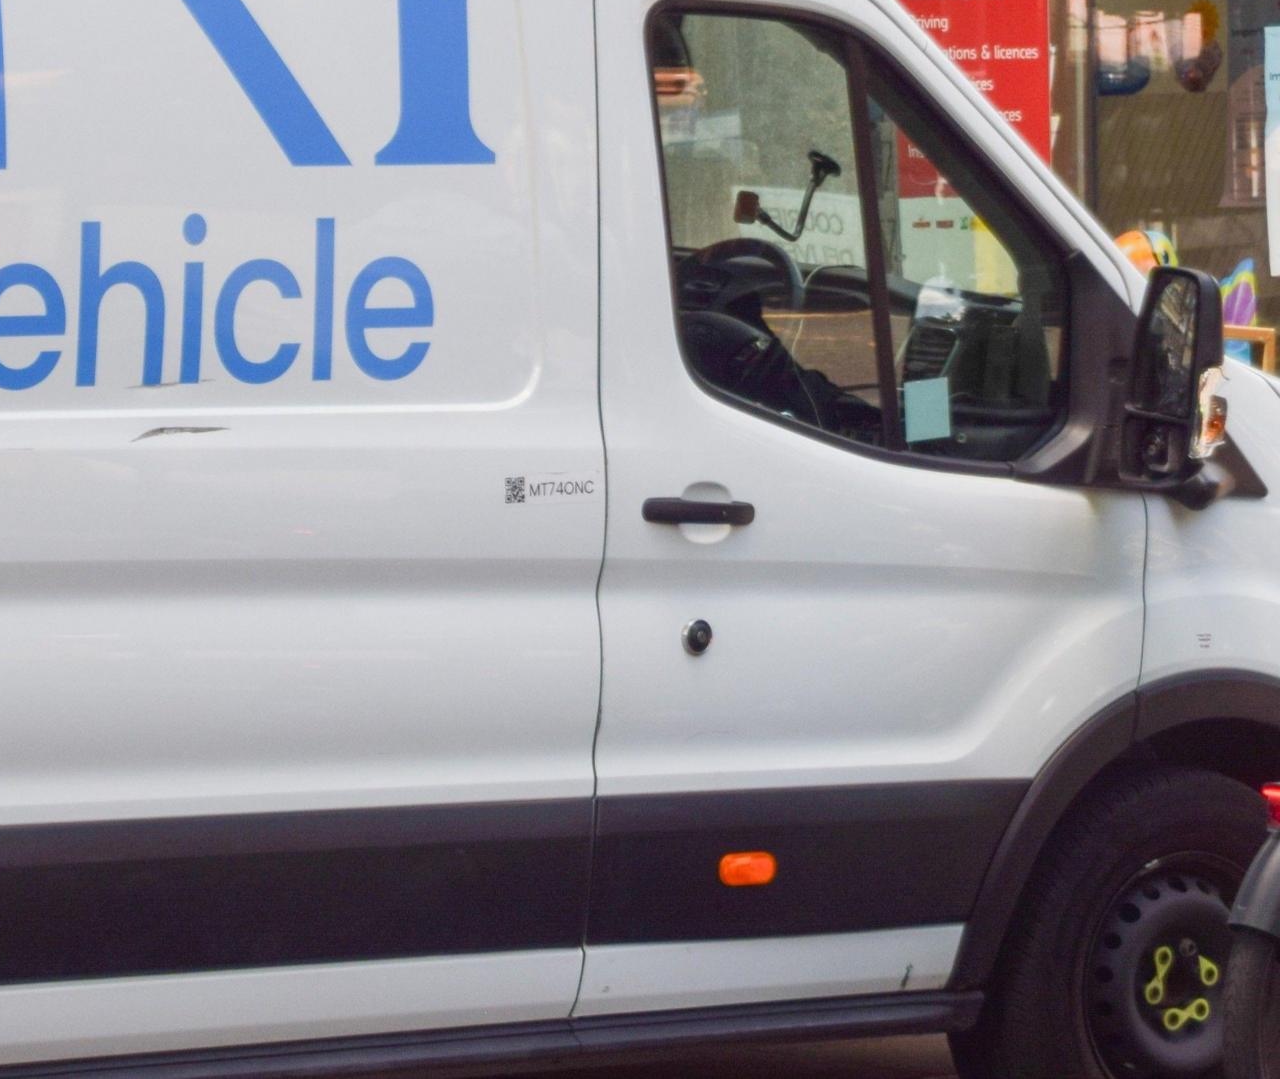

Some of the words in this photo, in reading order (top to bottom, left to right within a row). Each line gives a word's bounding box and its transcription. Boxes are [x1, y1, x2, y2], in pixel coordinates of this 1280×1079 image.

[980, 45, 990, 59] &
[994, 46, 1039, 59] licences
[529, 480, 594, 497] MT74ONC
